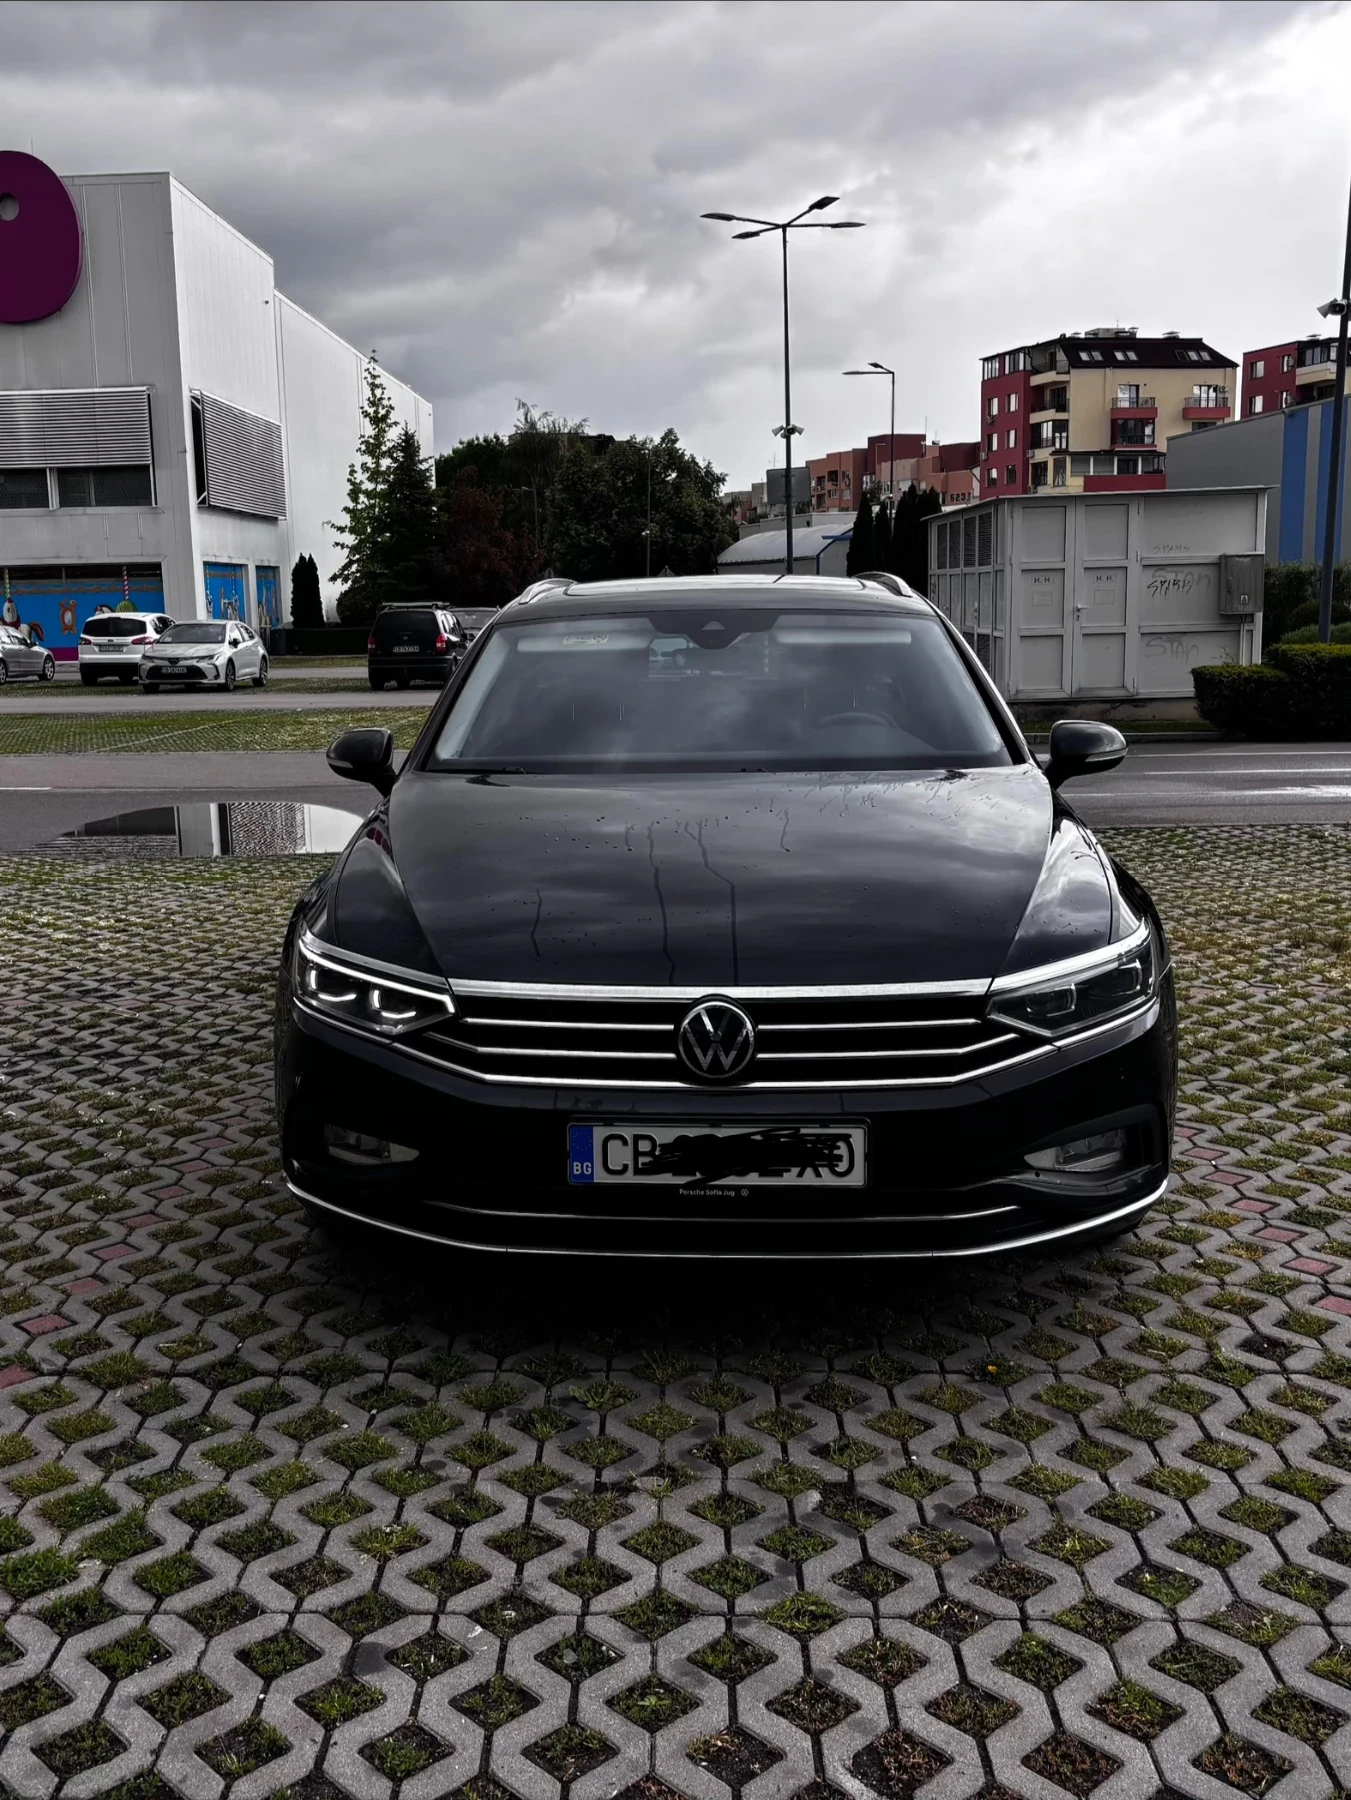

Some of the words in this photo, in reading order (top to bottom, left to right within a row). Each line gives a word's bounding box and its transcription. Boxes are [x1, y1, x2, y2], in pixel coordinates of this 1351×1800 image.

[683, 1006, 748, 1072] VW
[573, 1161, 592, 1175] BG
[679, 1188, 705, 1196] Porsche
[723, 1189, 735, 1197] Jug
